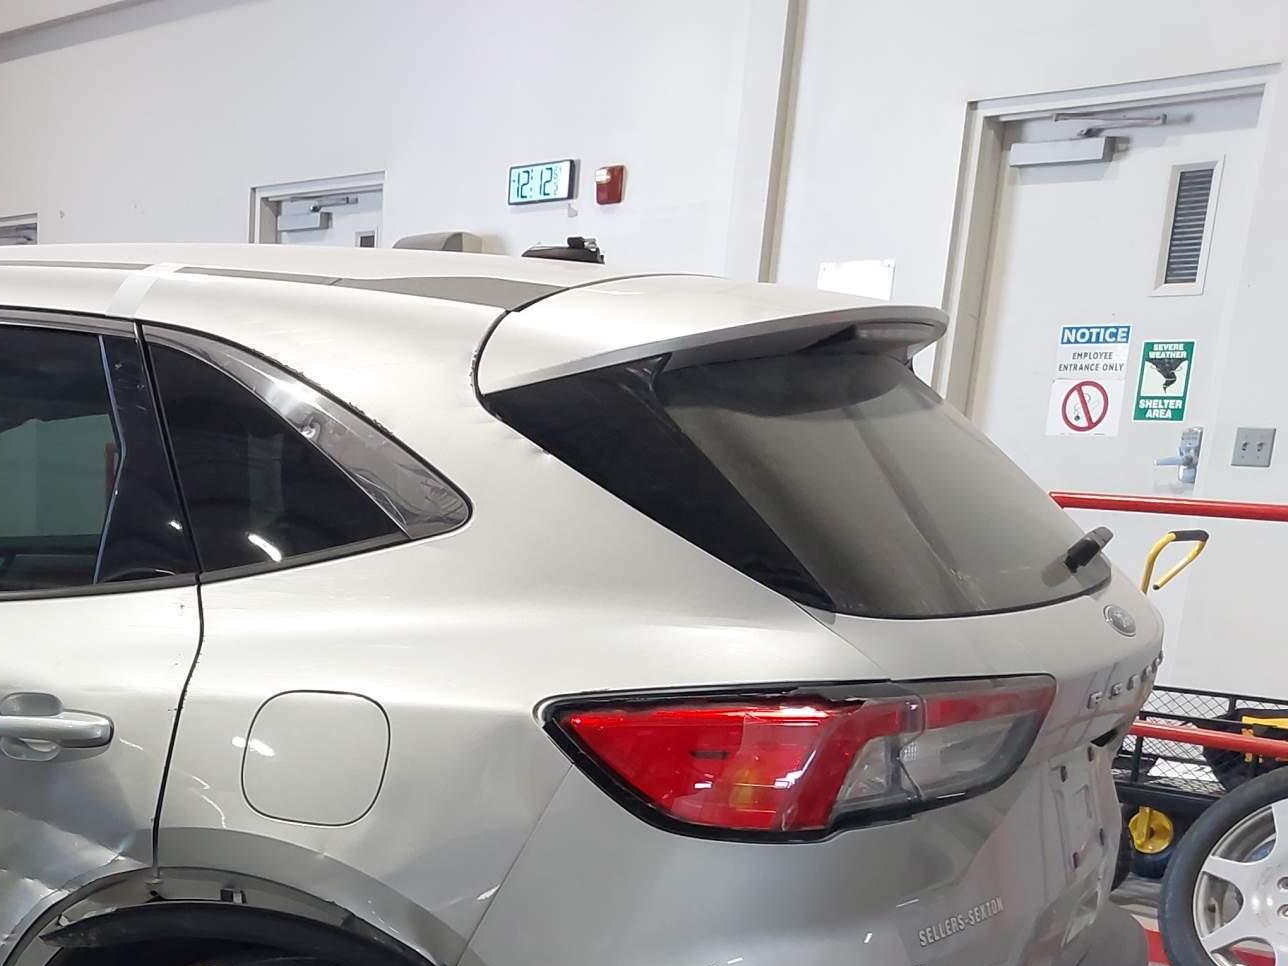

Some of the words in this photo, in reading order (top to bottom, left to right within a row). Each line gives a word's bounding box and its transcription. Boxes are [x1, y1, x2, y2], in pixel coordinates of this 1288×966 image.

[516, 166, 553, 199] 12:12
[1062, 327, 1128, 343] NOTICE
[1153, 343, 1185, 351] SEVERE
[1071, 351, 1114, 360] EMPLOYEE
[1148, 351, 1187, 359] WEATHER
[1058, 363, 1100, 372] ENTRANCE
[1102, 362, 1125, 372] ONLY
[1138, 398, 1183, 409] SHELTER
[1145, 409, 1172, 419] AREA
[919, 896, 1004, 947] SELLERS-SEXTON
